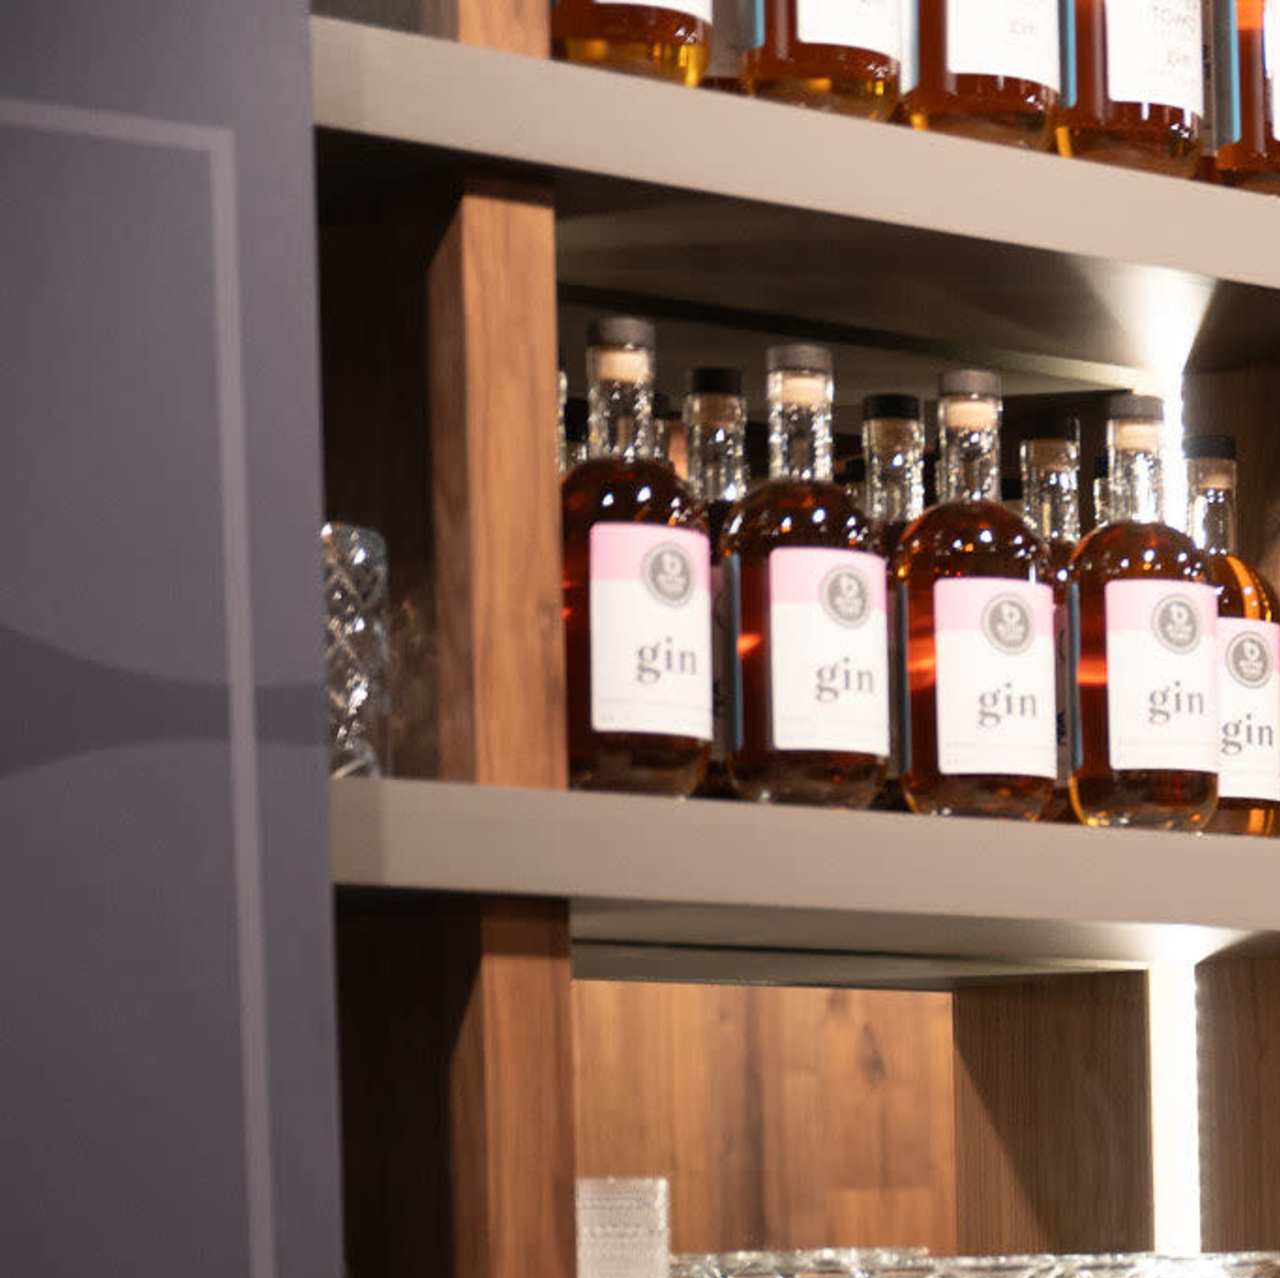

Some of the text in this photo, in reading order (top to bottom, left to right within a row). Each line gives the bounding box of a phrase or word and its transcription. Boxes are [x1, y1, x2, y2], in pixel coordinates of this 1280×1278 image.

[637, 636, 697, 685] gin
[816, 657, 874, 703] gin
[978, 682, 1036, 728] gin
[1148, 680, 1204, 725] gin
[1220, 713, 1273, 756] gin
